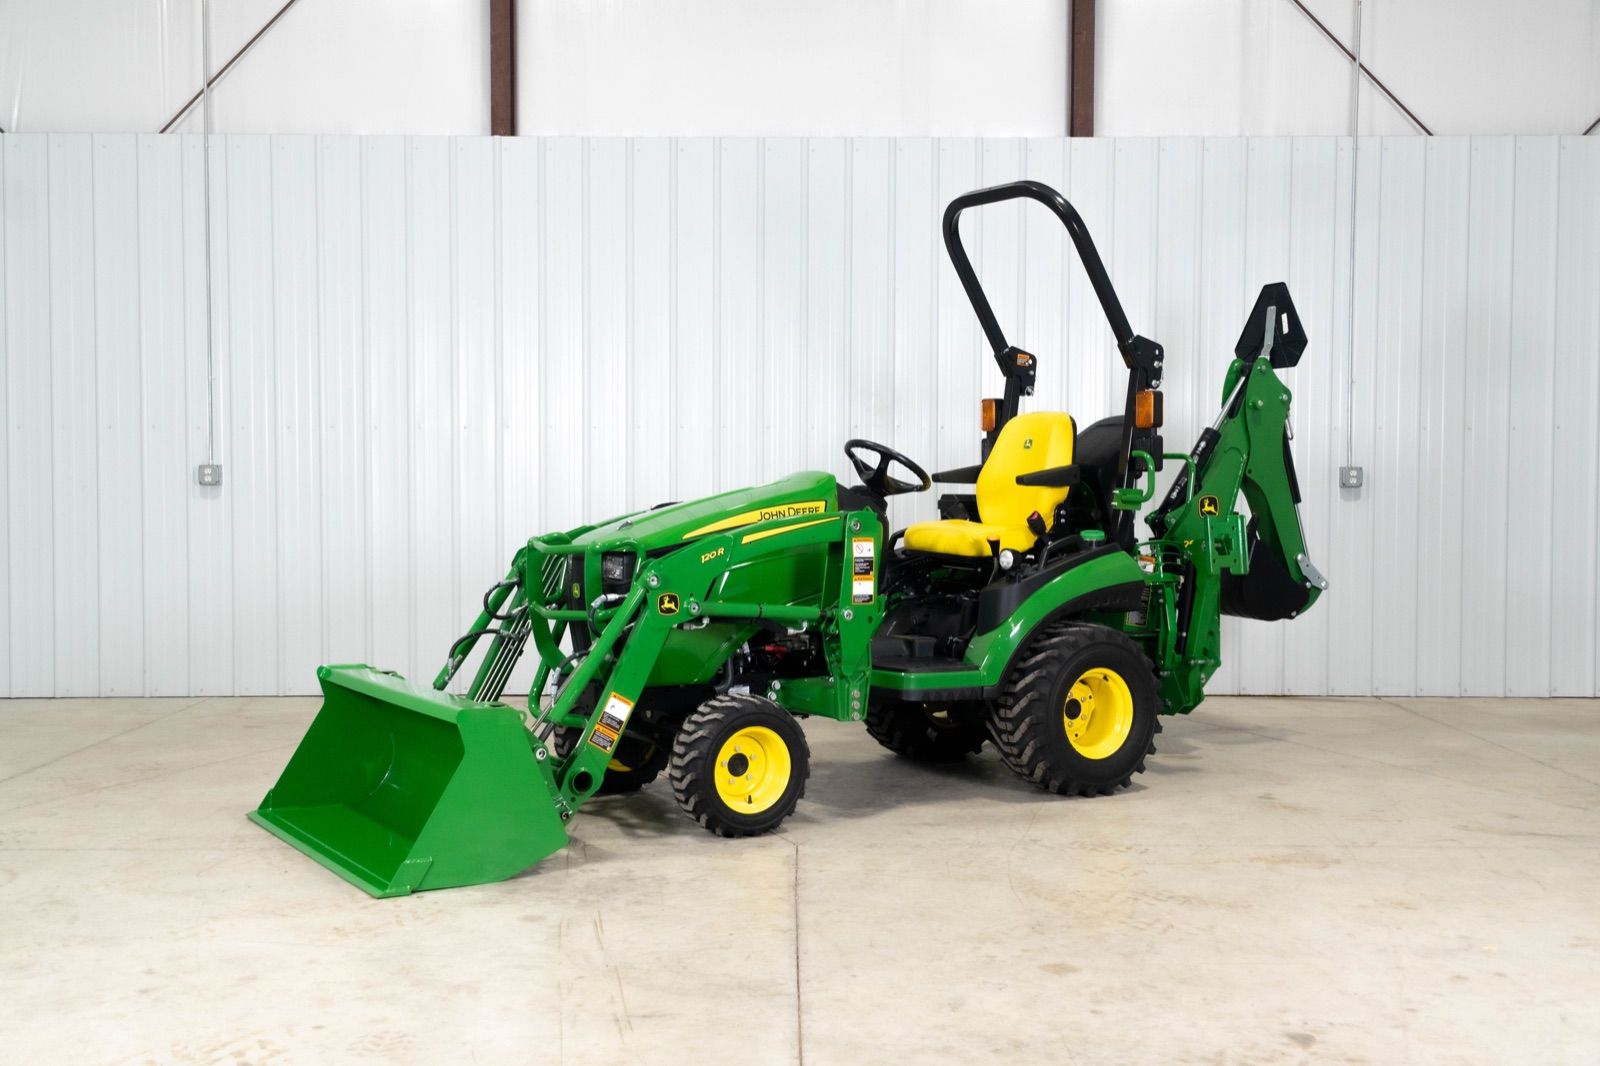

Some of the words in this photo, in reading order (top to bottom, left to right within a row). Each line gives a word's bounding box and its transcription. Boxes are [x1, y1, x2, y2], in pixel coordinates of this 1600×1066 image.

[757, 510, 786, 522] JOHN
[701, 551, 716, 564] 120
[717, 547, 725, 556] R
